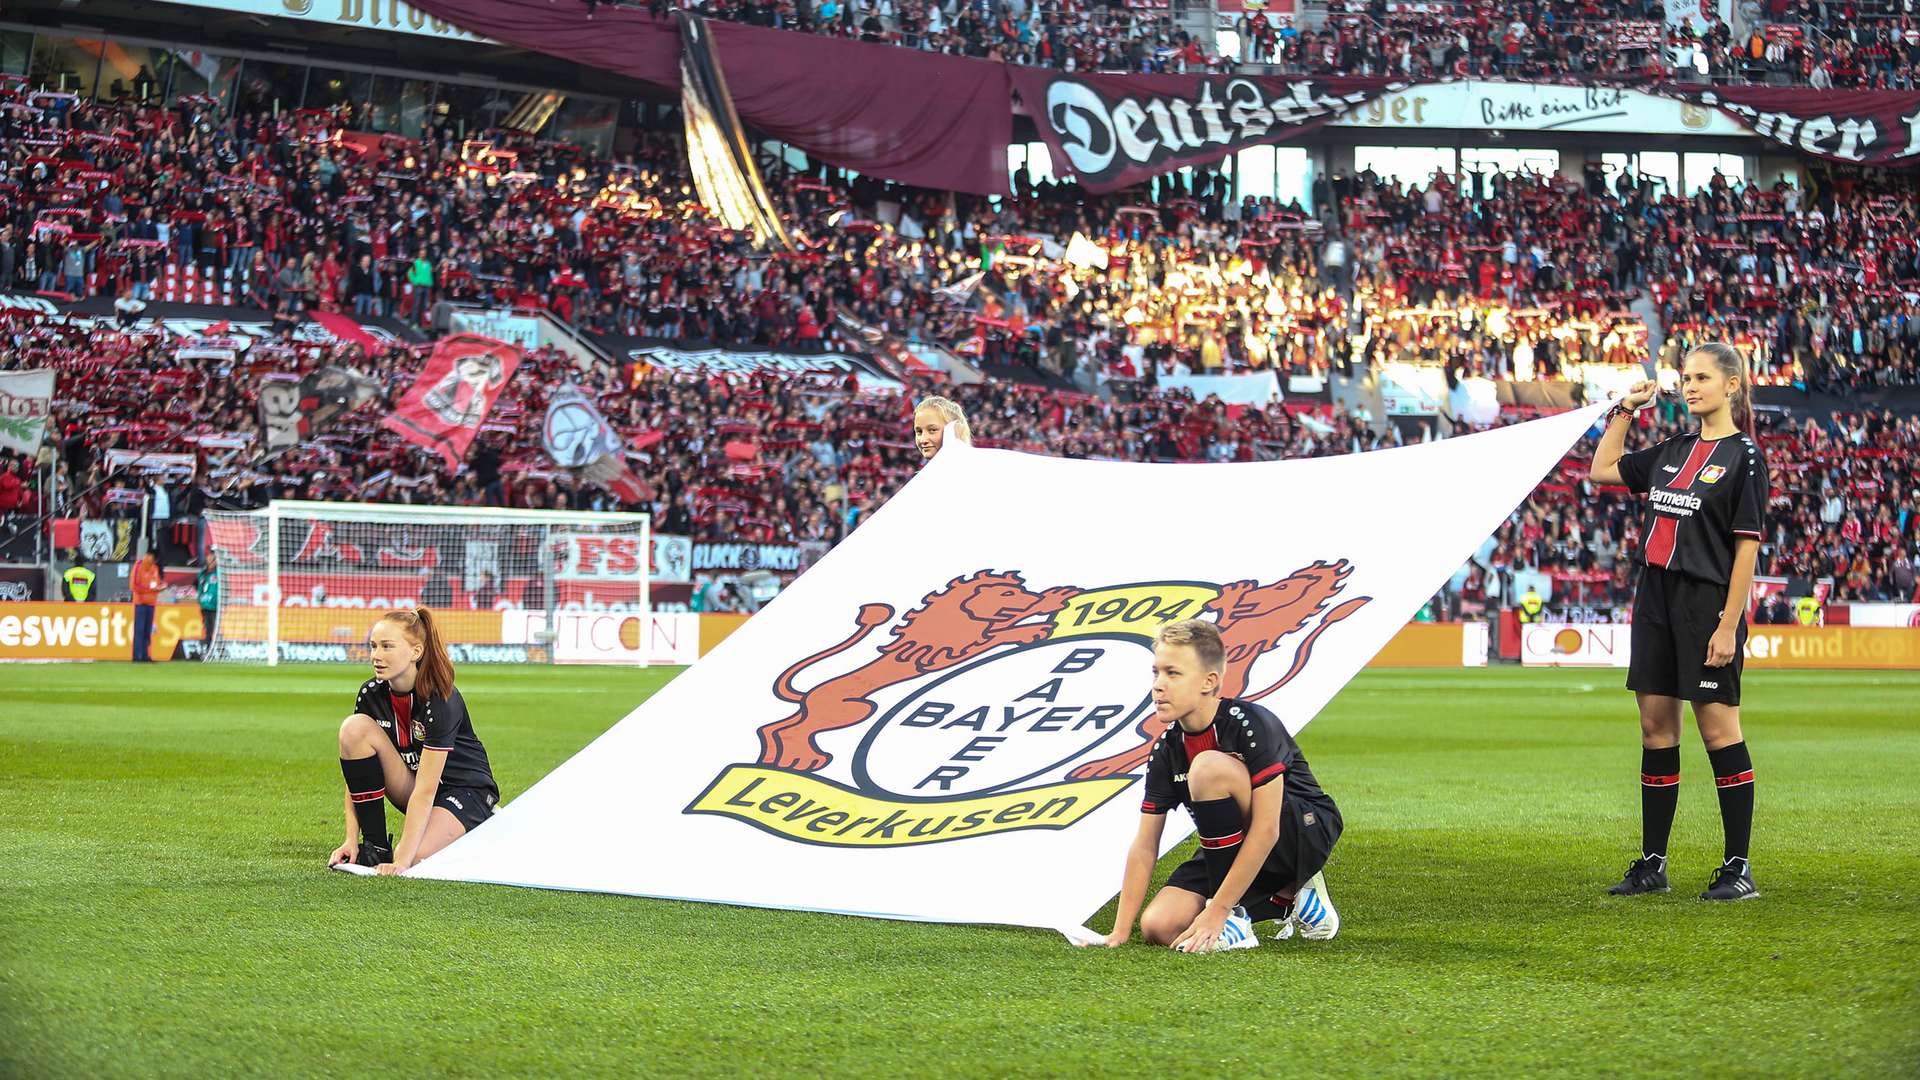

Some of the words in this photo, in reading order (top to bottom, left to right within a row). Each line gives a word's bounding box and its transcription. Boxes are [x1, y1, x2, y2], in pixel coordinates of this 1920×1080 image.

[1481, 98, 1534, 126] Bitte
[1539, 103, 1580, 118] ein
[1585, 87, 1630, 111] Bit
[0, 608, 133, 646] esweit
[1072, 596, 1195, 628] 1904
[1789, 629, 1842, 657] und
[1699, 680, 1719, 690] JAKO
[899, 701, 1125, 732] BAYER
[724, 777, 1079, 839] Leverkusen
